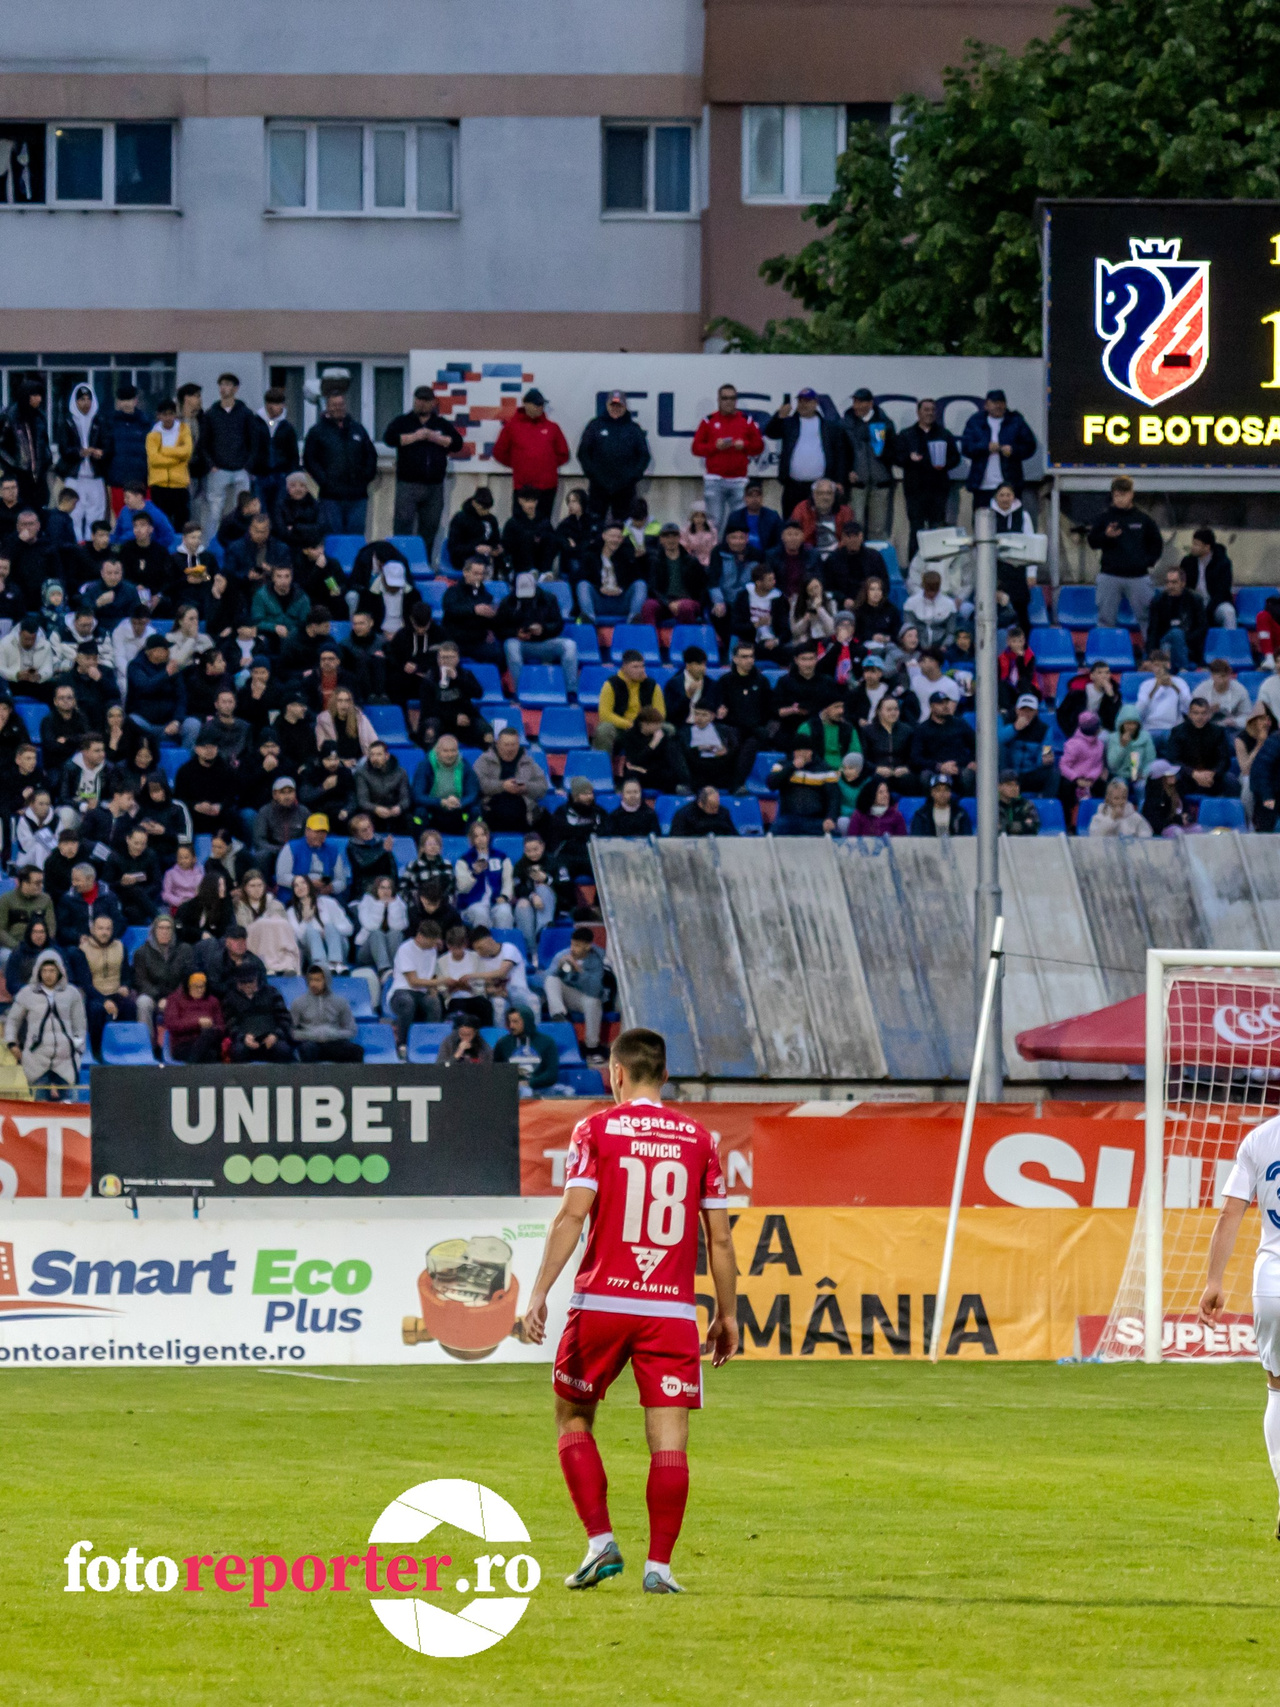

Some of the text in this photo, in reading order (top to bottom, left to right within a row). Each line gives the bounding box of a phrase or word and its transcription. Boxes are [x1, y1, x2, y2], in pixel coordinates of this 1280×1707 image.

[1083, 416, 1130, 447] FC
[170, 1086, 442, 1143] UNIBET
[619, 1115, 696, 1134] Regata.ro
[631, 1141, 681, 1159] PAVICIC
[619, 1157, 688, 1247] 18
[28, 1250, 373, 1296] Smart Eco
[632, 1281, 680, 1295] GAMING
[264, 1299, 363, 1334] Plus
[695, 1277, 999, 1356] OMÂNIA
